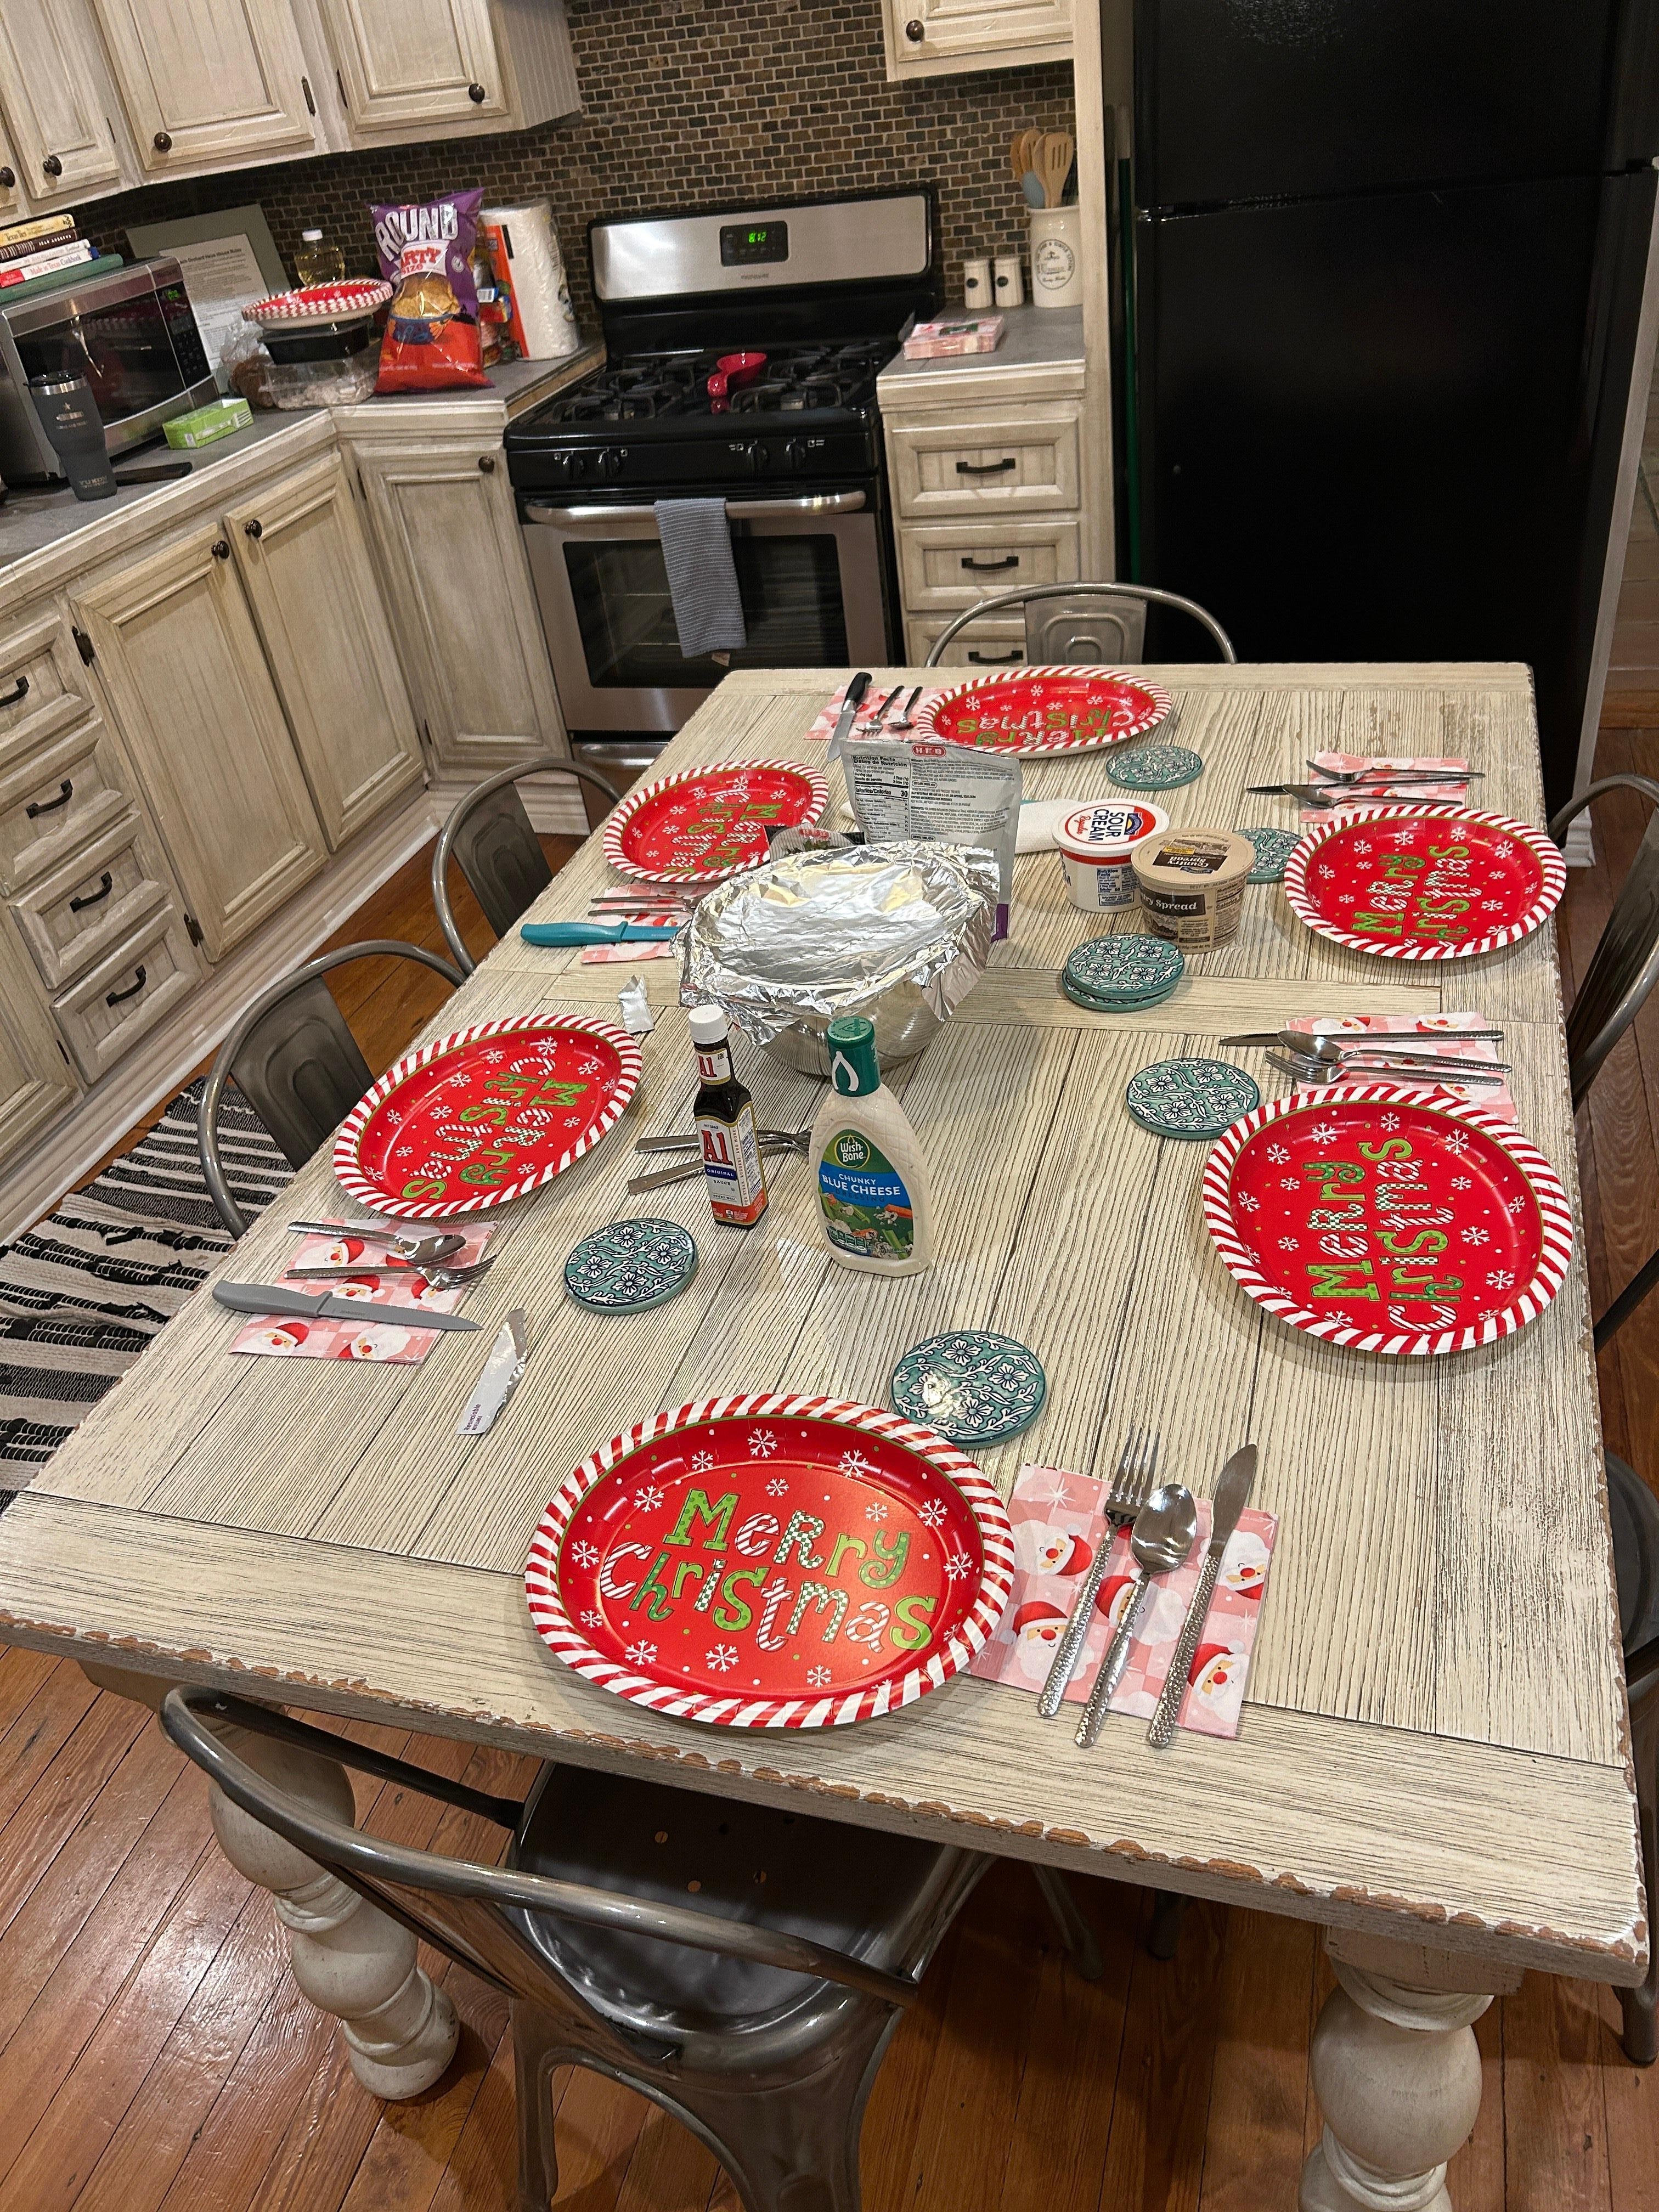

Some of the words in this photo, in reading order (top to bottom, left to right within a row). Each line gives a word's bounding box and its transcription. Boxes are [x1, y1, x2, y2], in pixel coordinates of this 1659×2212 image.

[375, 203, 458, 262] ROUND
[1088, 809, 1109, 841] CREAM
[1105, 812, 1125, 837] SOUR
[1156, 899, 1197, 910] Spread
[840, 1141, 864, 1153] Wish-
[842, 1152, 865, 1162] Bone
[707, 1169, 734, 1177] ORIGINAL
[838, 1173, 876, 1186] CHUNKY
[821, 1174, 848, 1191] BLUE
[851, 1184, 901, 1195] CHEESE
[836, 1188, 885, 1203] DRESSING
[464, 1404, 481, 1431] Resealable
